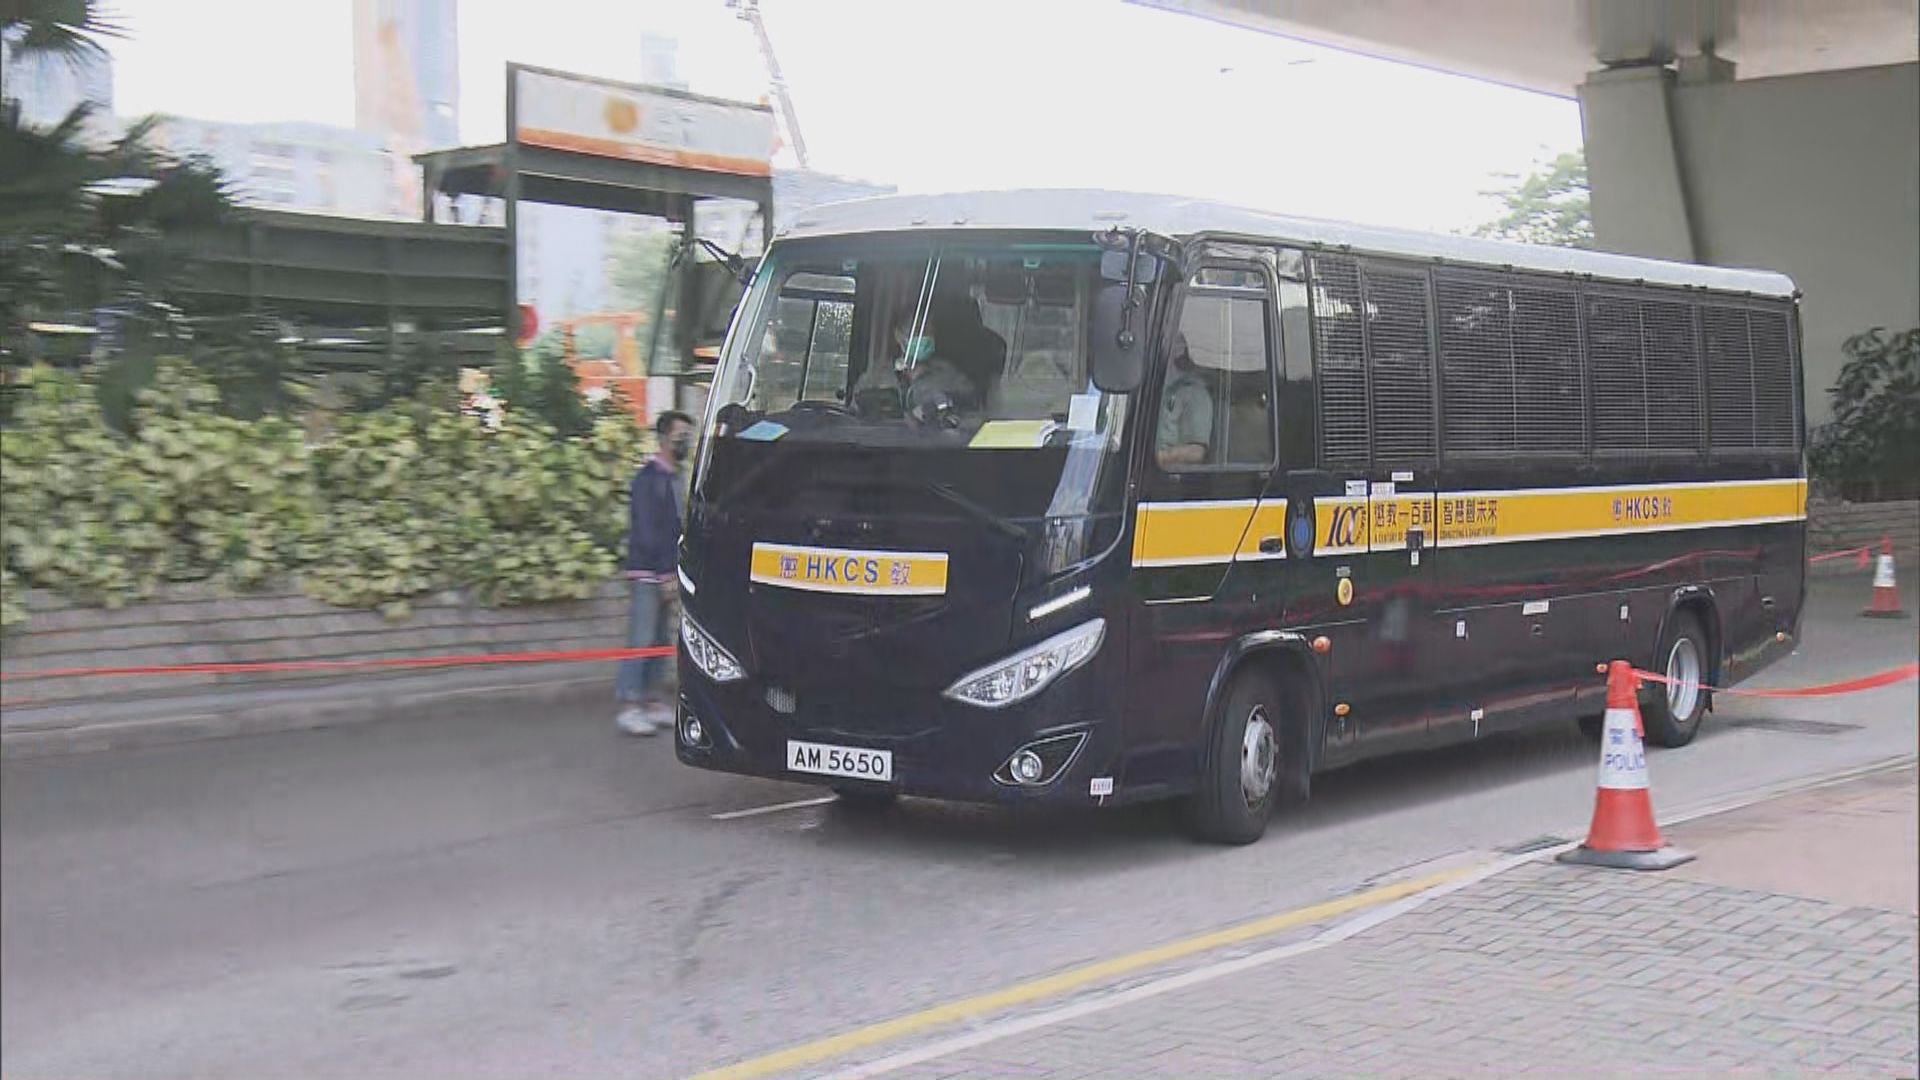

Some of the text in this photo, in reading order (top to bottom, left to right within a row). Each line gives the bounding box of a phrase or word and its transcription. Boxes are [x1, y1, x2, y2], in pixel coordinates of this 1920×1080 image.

[1625, 495, 1660, 519] HKCS
[806, 554, 880, 584] HKCS
[794, 746, 885, 775] AM 5650
